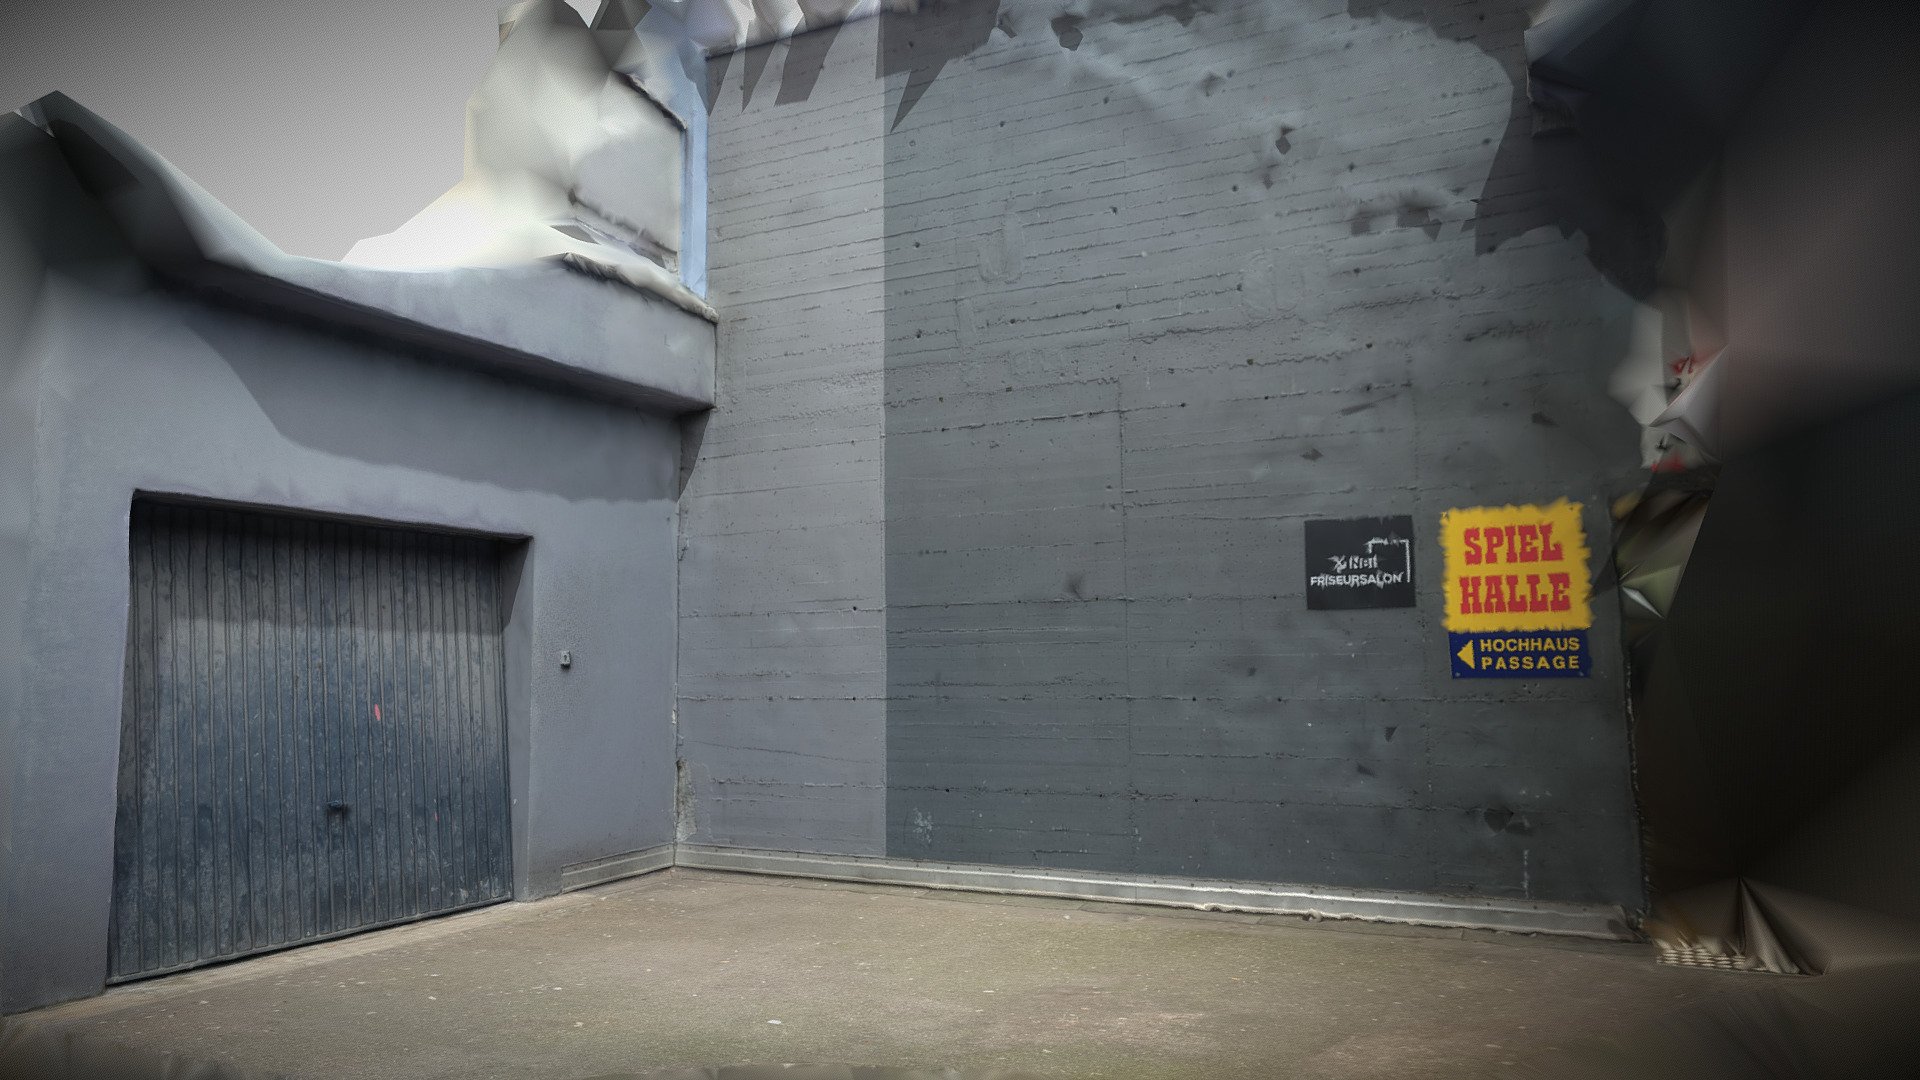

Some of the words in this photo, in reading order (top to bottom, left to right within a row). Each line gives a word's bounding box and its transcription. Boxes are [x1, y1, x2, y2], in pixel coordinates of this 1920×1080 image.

[1463, 521, 1563, 564] SPIEL
[1310, 573, 1402, 588] FRISEURSALON
[1459, 572, 1571, 615] HALLE
[1480, 637, 1580, 652] HOCHHAUS
[1481, 656, 1580, 670] PASSAGE
